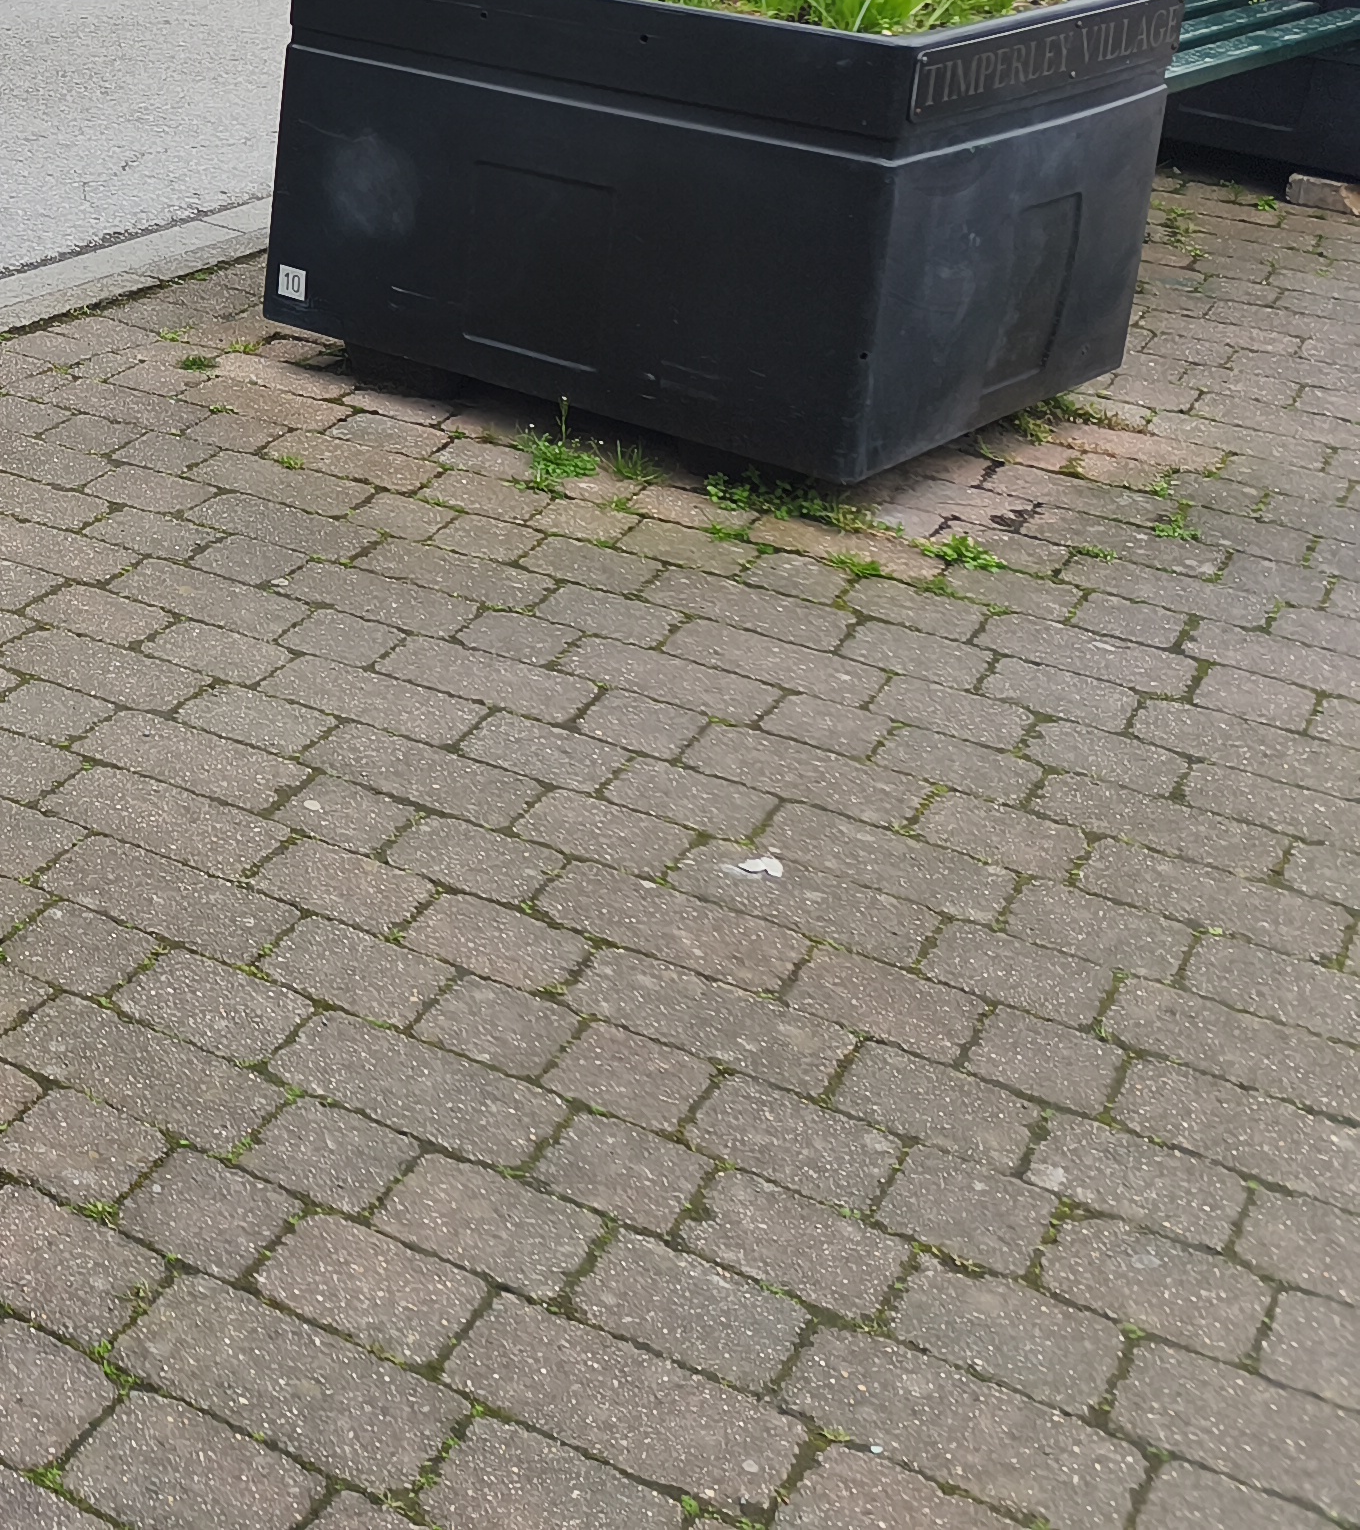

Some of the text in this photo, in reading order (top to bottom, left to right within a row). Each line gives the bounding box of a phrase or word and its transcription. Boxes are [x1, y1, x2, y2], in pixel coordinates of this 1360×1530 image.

[924, 4, 1181, 107] TIMPERLEY VILLAGE
[284, 272, 301, 294] 10
